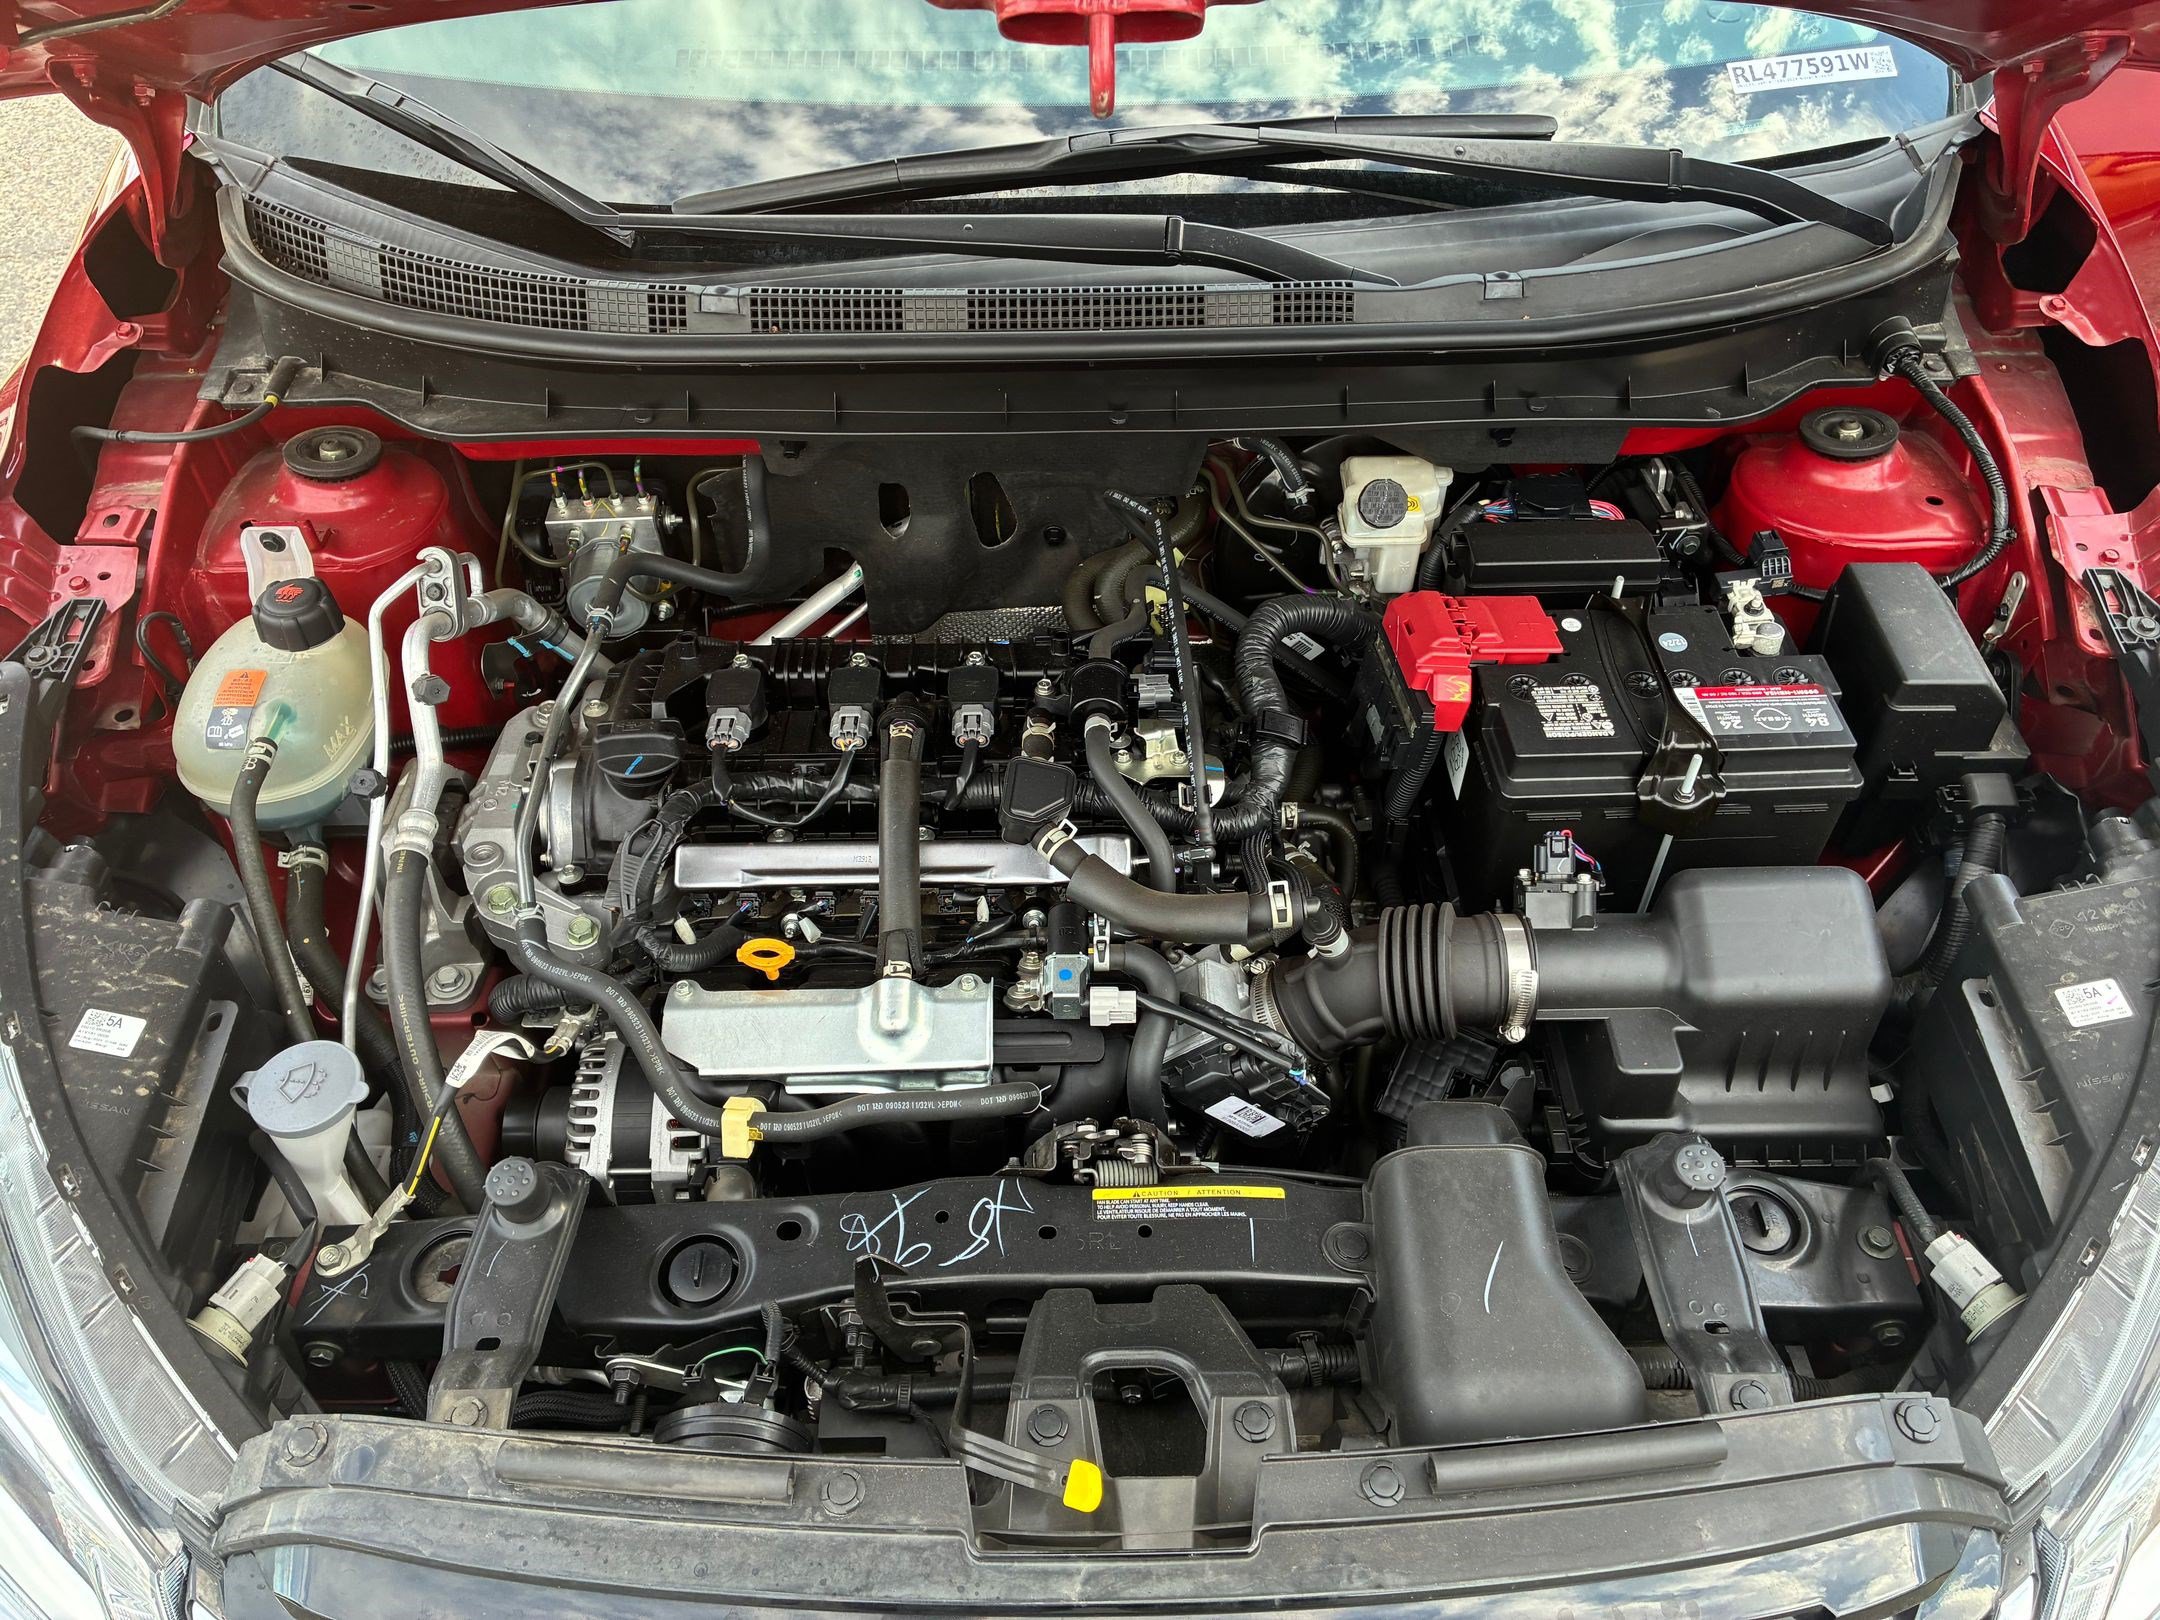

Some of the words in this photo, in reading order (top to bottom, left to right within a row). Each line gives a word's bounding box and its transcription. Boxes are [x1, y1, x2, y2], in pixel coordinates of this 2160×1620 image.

[1732, 52, 1869, 84] RL477591W
[1720, 720, 1744, 729] 24
[1804, 717, 1830, 727] 84
[605, 986, 619, 998] DOT
[2082, 987, 2102, 999] 5A
[106, 1015, 123, 1029] 5A
[857, 1102, 870, 1112] DOT
[885, 1100, 910, 1110] 090523
[980, 1097, 993, 1106] DOT
